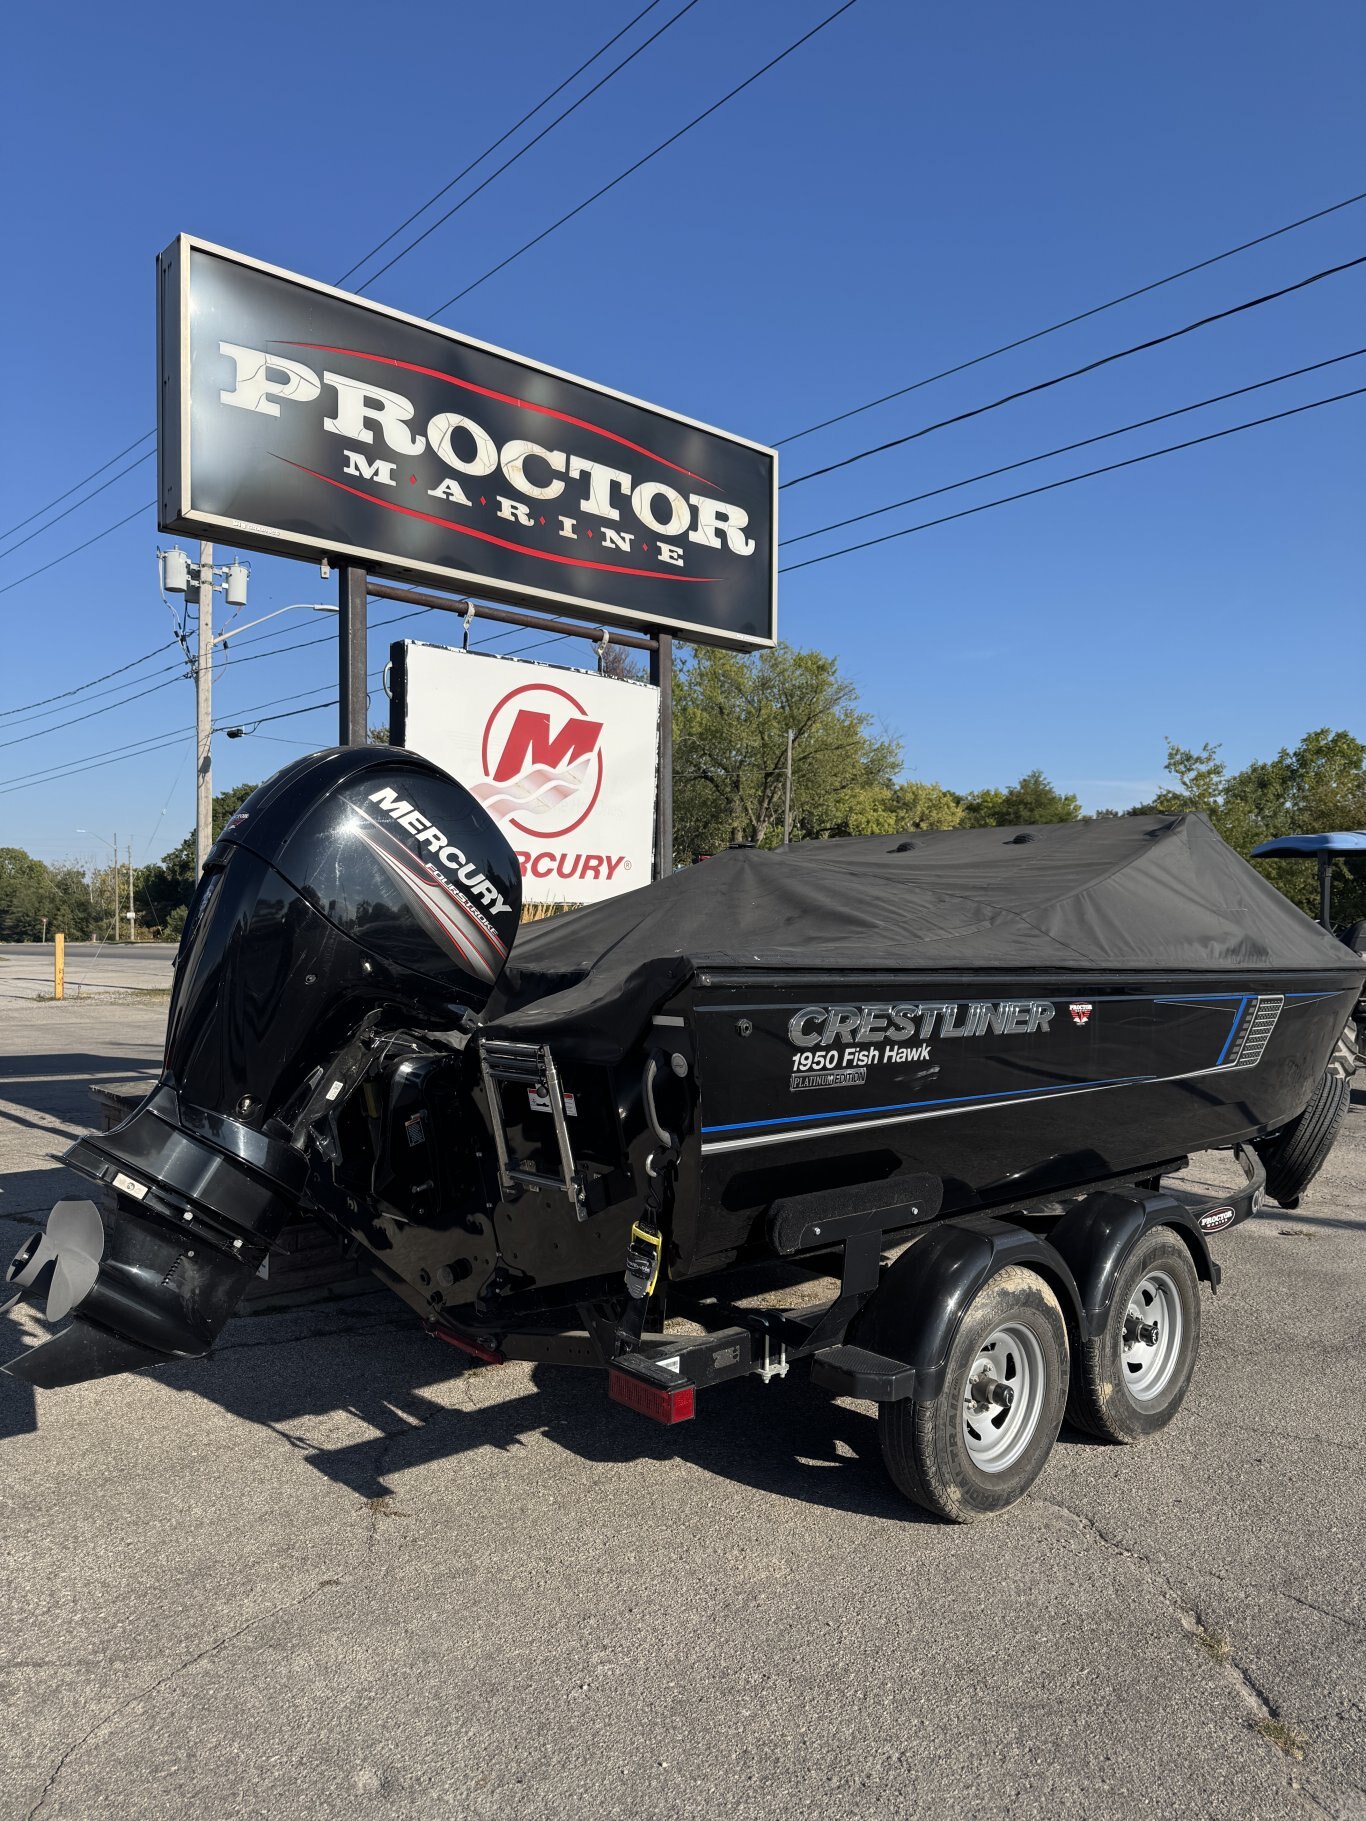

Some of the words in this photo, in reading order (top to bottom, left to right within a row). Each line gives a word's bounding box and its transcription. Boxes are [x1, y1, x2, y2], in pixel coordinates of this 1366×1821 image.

[218, 340, 756, 557] PROCTOR
[367, 787, 513, 915] MERCURY
[425, 862, 499, 937] FOURSTROKE
[788, 1001, 1055, 1048] CRESTLINER
[792, 1050, 839, 1071] 1950
[842, 1046, 879, 1067] Fish
[883, 1043, 932, 1064] Hawk
[793, 1074, 834, 1088] PLATINUM
[834, 1070, 866, 1084] EDITION
[1201, 1210, 1233, 1226] PROCTOR
